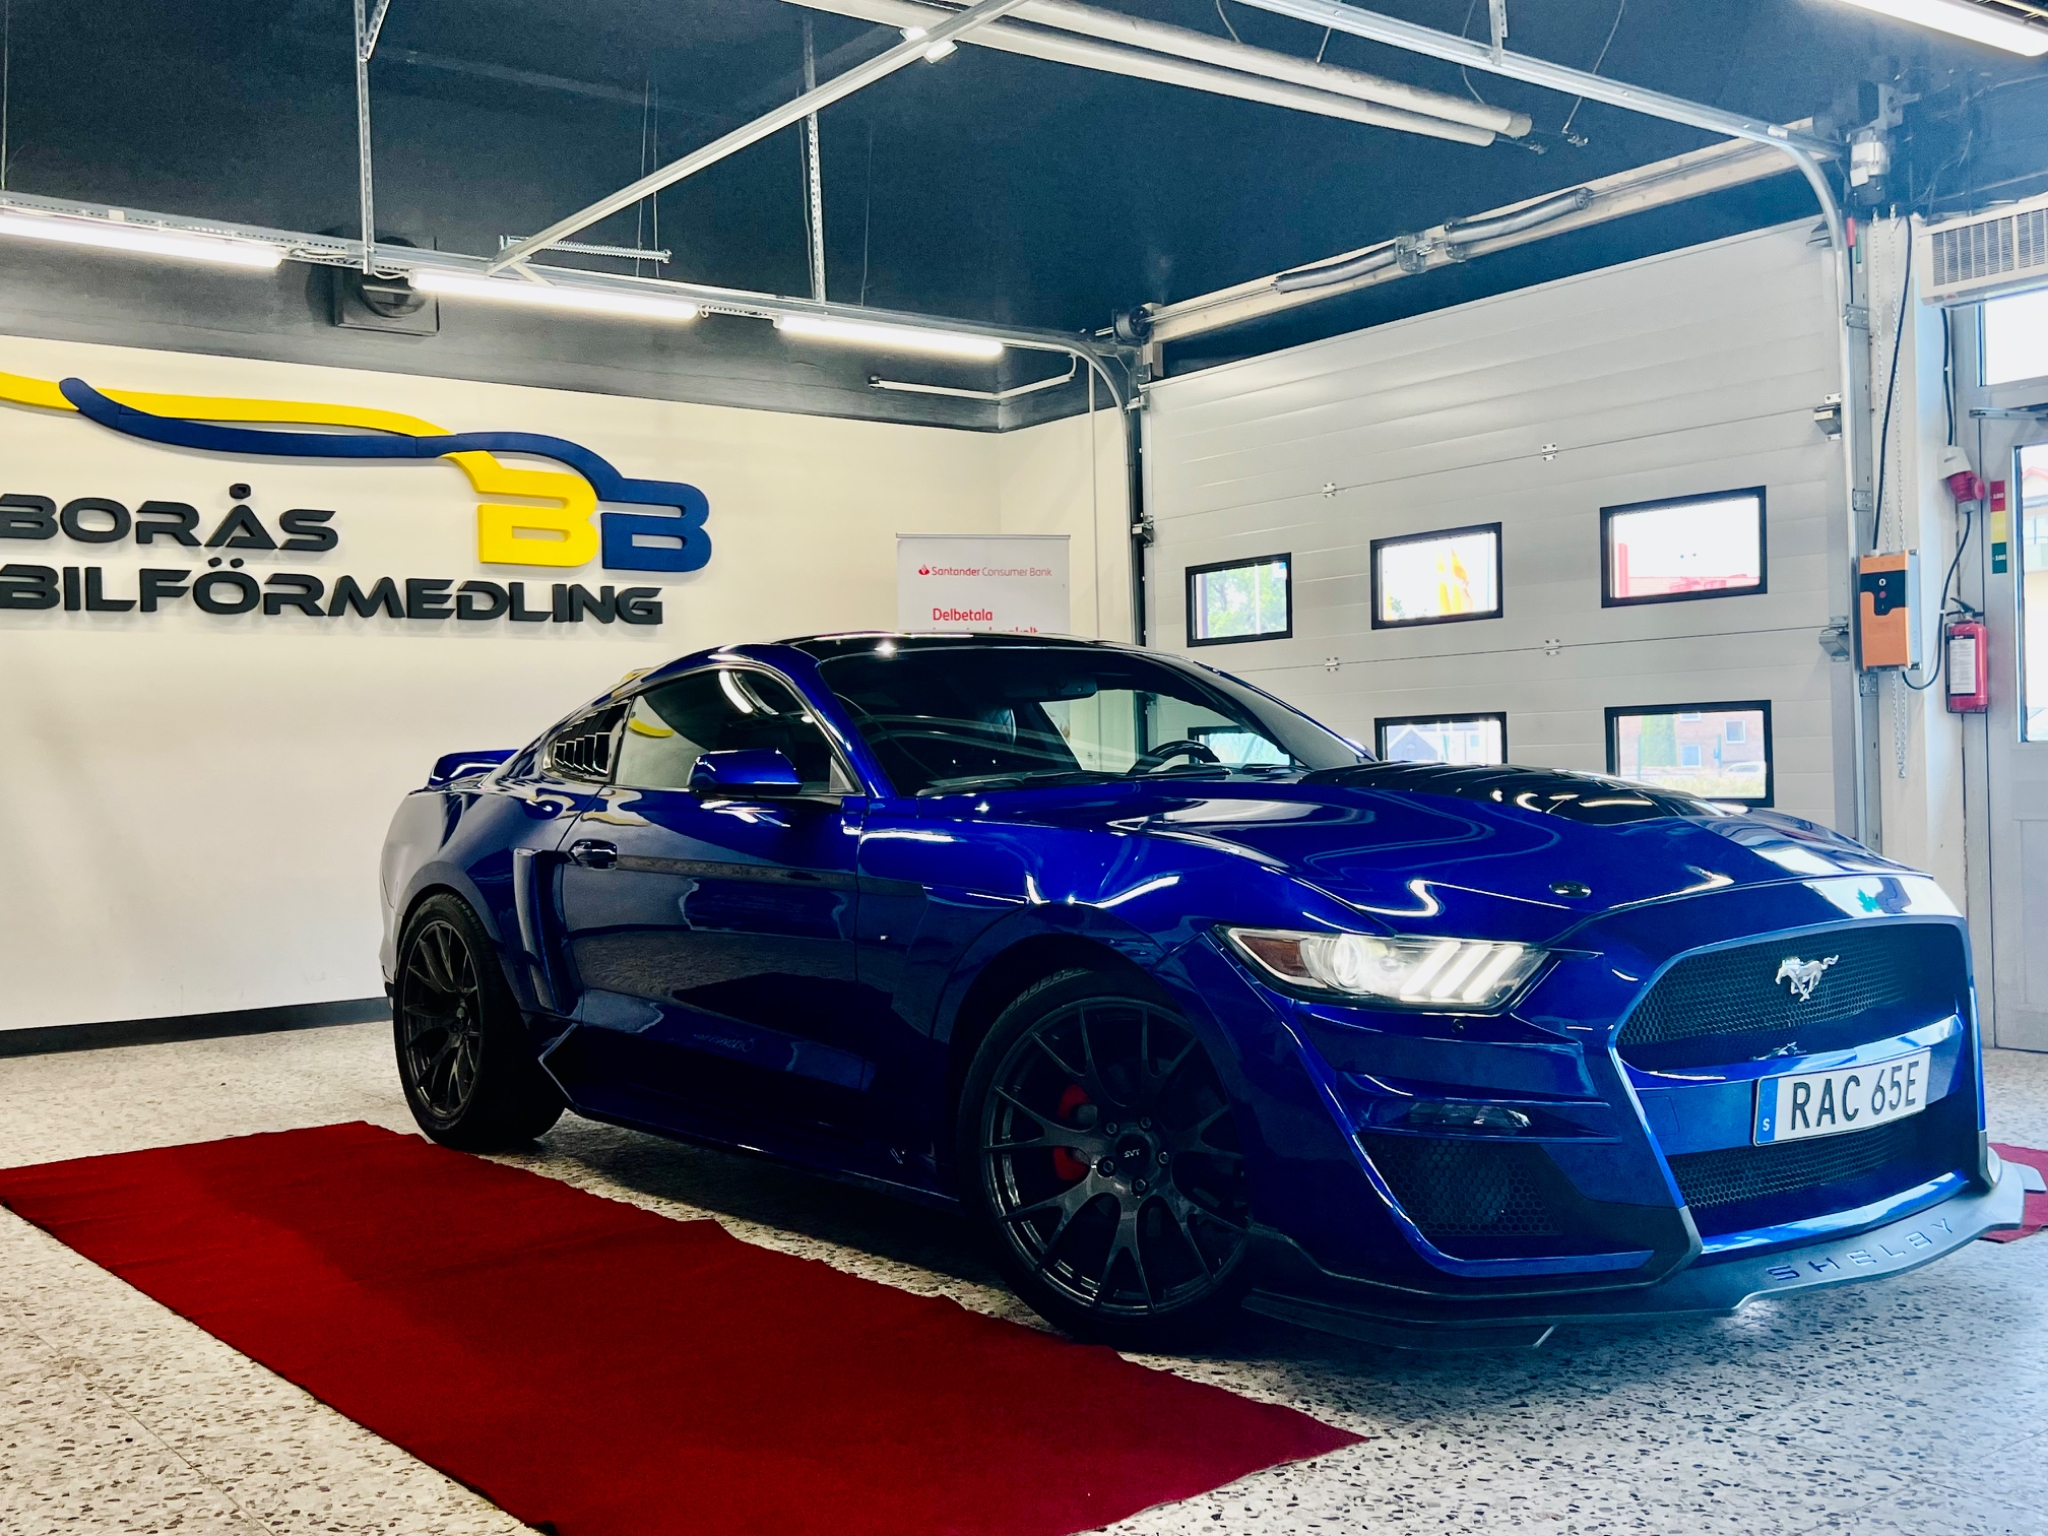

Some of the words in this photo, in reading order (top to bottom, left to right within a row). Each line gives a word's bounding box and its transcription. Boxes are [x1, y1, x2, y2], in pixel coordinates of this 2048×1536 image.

[0, 483, 338, 552] BORÅS
[0, 557, 663, 625] BILFÖRMEDLING
[931, 566, 980, 577] Santander
[982, 567, 1028, 577] Consumer
[1030, 567, 1053, 577] Bank
[932, 607, 993, 621] Delbetala
[1762, 1118, 1771, 1131] S
[1791, 1075, 1860, 1131] RAC
[1871, 1060, 1920, 1116] 65E
[1766, 1218, 1953, 1281] SHELBY
